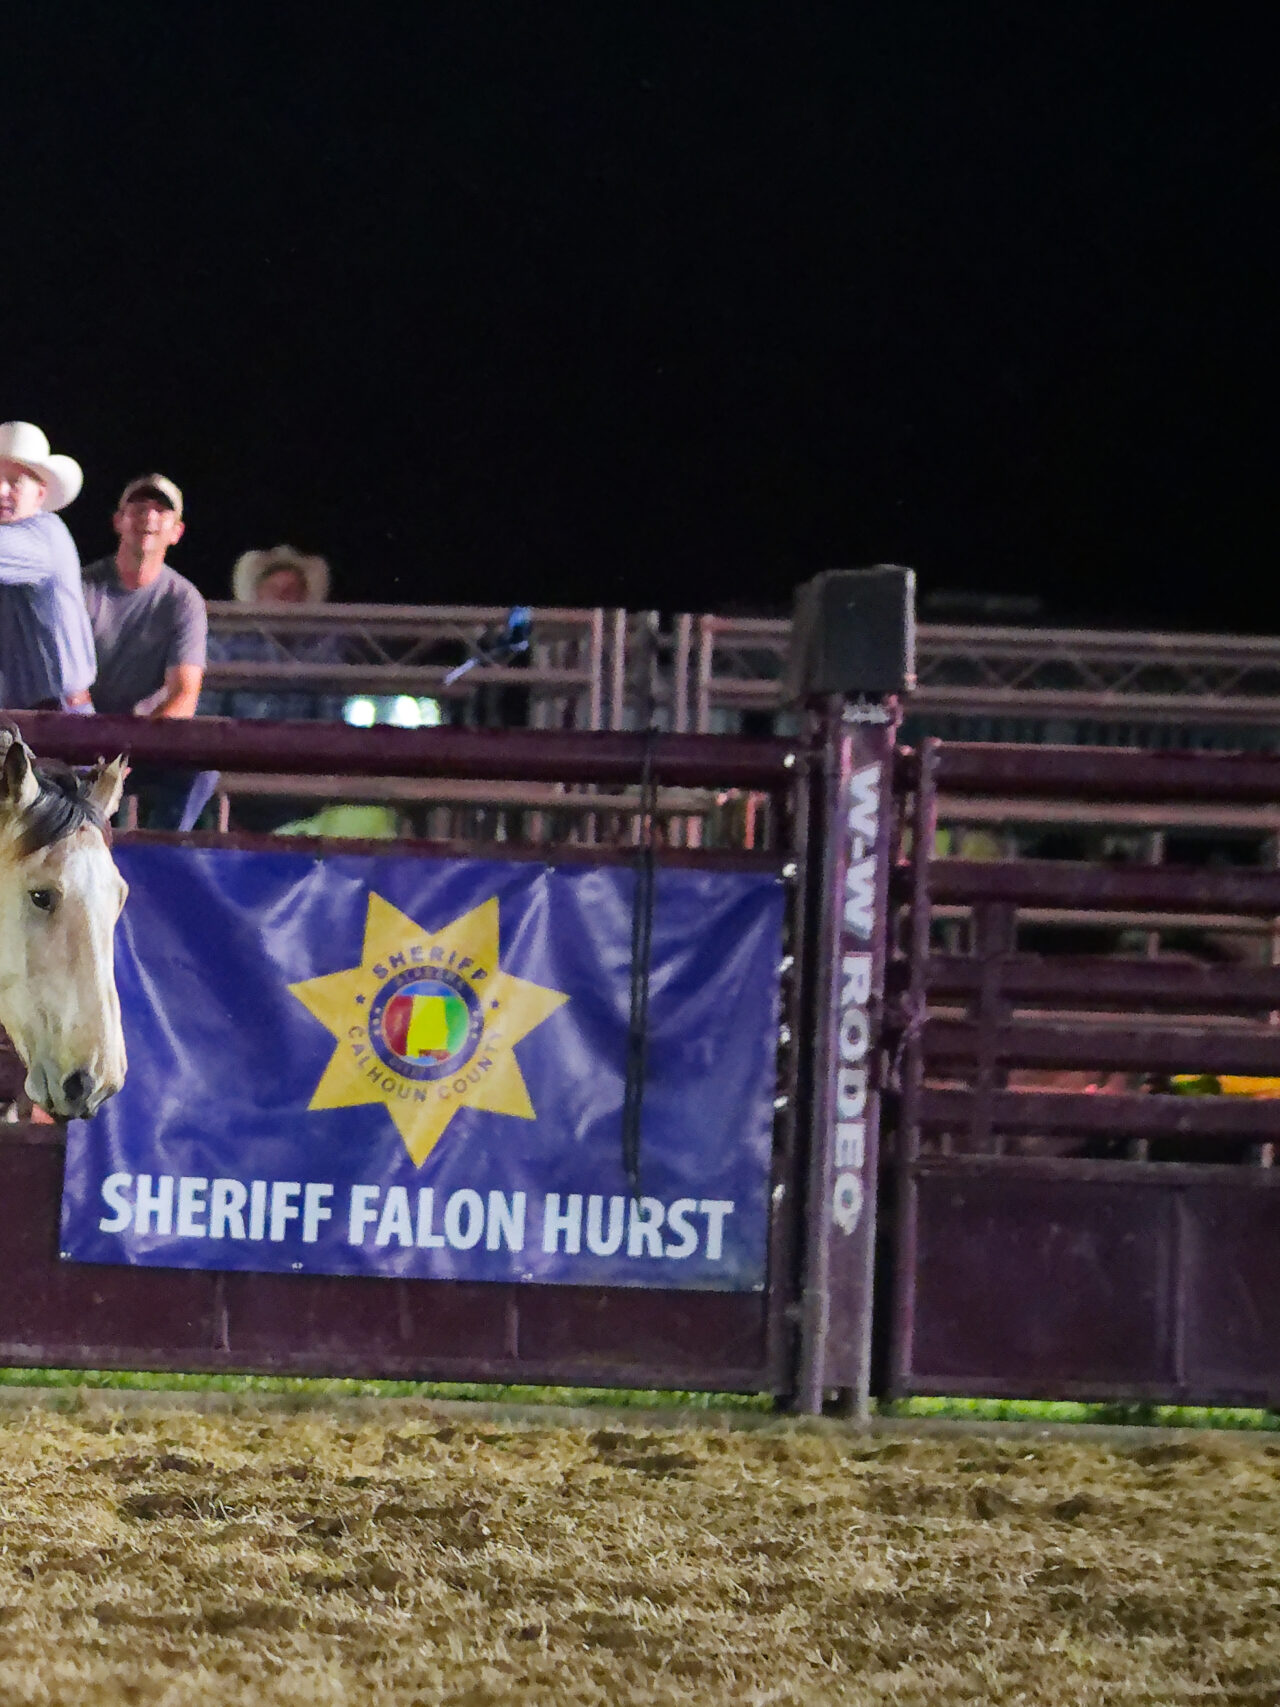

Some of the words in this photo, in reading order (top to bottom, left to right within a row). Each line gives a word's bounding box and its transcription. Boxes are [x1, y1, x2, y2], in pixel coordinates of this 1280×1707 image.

[843, 760, 883, 941] W-W
[372, 945, 488, 980] SHERIFF
[348, 1025, 427, 1103] CALHOUN
[437, 1031, 502, 1100] COUNTY
[832, 951, 873, 1236] RODEO
[99, 1171, 334, 1243] SHERIFF
[347, 1184, 526, 1252] FALON
[542, 1193, 734, 1261] HURST
